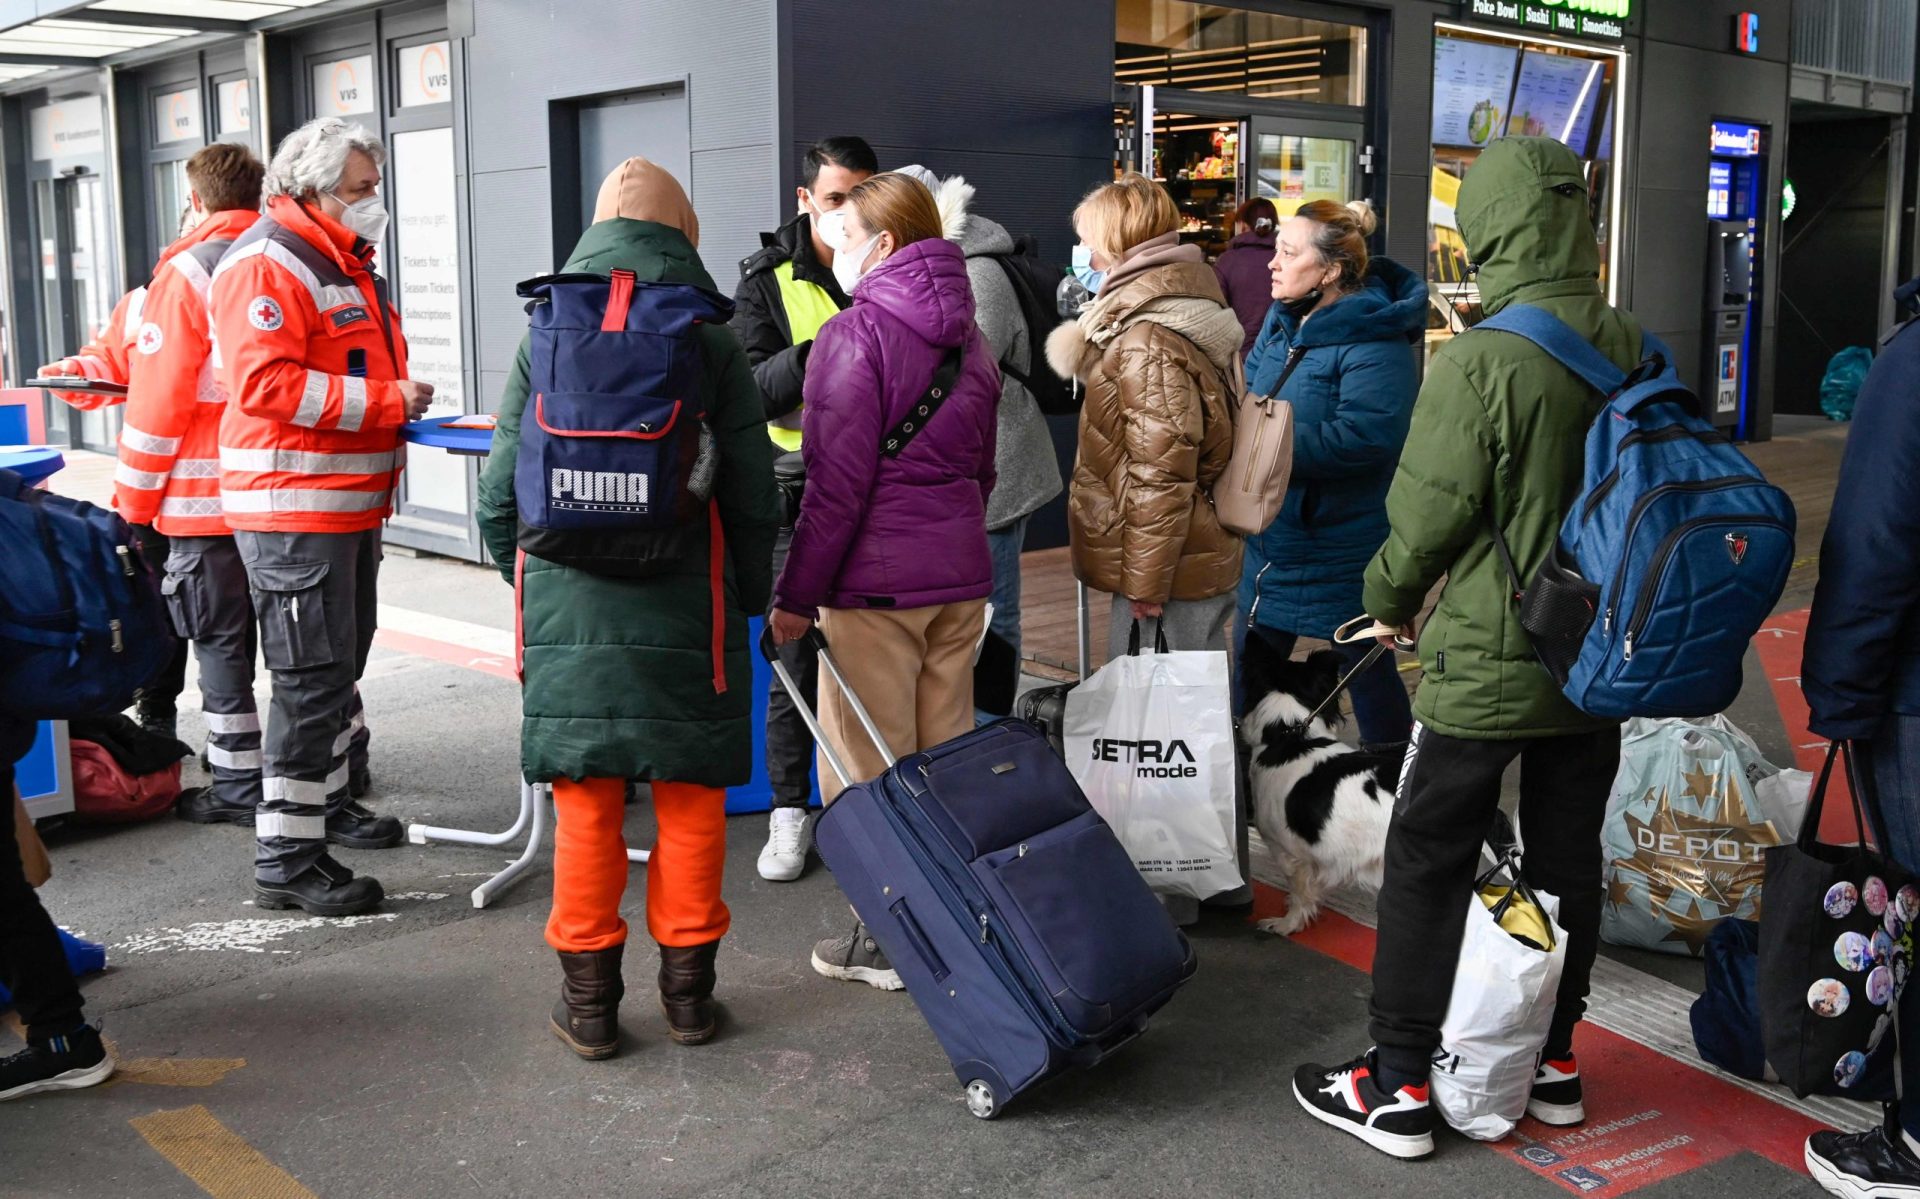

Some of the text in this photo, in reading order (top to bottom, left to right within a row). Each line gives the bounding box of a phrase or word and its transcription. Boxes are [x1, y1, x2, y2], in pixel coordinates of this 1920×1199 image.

[1472, 0, 1495, 16] Poke
[1496, 2, 1518, 20] Bowl
[1525, 6, 1550, 25] Sushi
[1557, 13, 1576, 30] Wok
[1582, 17, 1622, 39] Smoothies
[1739, 12, 1758, 52] EC
[427, 74, 448, 88] VVS
[340, 88, 358, 101] VVS
[404, 256, 440, 267] Tickets for
[404, 282, 455, 294] Season Tickets
[405, 308, 452, 322] Subscriptions
[1719, 390, 1736, 407] ATM
[552, 468, 649, 503] PUMA
[1092, 738, 1196, 763] SETRA
[1137, 764, 1197, 778] mode
[1637, 826, 1769, 862] DEPOT
[1550, 1132, 1586, 1148] VVS
[1580, 1109, 1664, 1138] Fahrkarten
[1591, 1133, 1695, 1170] Wartebereich
